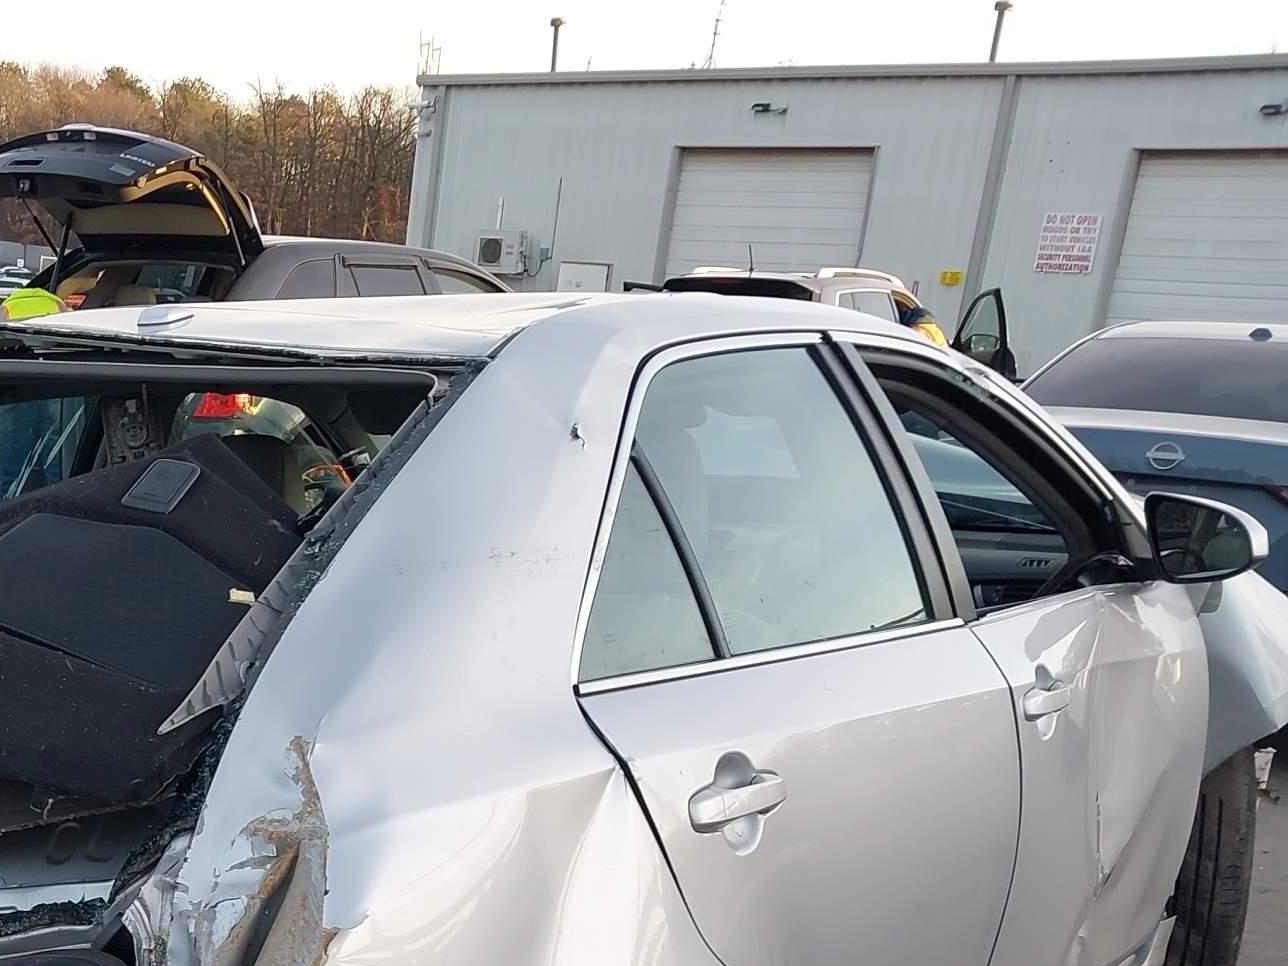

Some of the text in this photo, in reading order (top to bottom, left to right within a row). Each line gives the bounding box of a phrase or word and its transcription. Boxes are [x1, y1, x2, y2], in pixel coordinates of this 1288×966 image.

[1046, 214, 1097, 226] DO NOT OPEN
[1042, 226, 1098, 235] HOODS OR TRY
[1040, 234, 1096, 244] TO START VEHICLES
[1039, 244, 1075, 253] WITHOUT
[1037, 253, 1091, 262] SECURITY PERSONNEL
[1035, 262, 1090, 272] AUTHORIZATION
